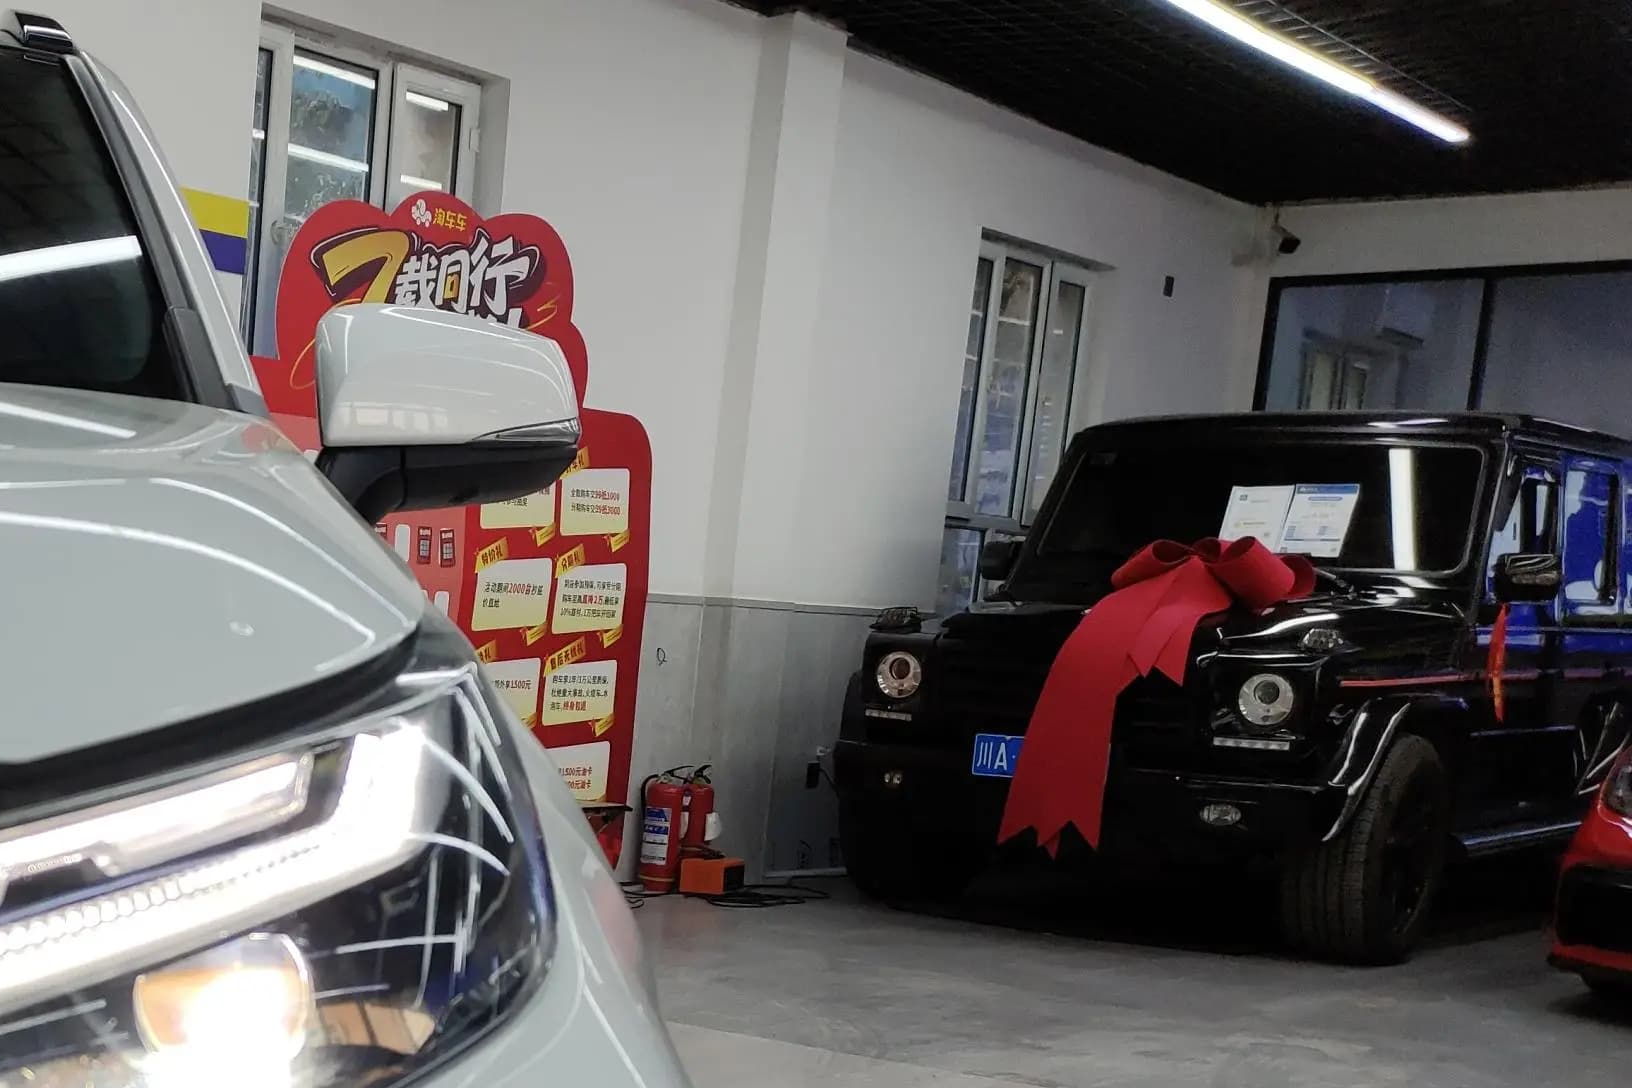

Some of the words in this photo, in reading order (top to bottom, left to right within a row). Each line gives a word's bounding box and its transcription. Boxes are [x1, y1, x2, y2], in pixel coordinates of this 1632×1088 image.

[432, 207, 467, 232] 淘车车
[481, 544, 503, 566] 特价礼
